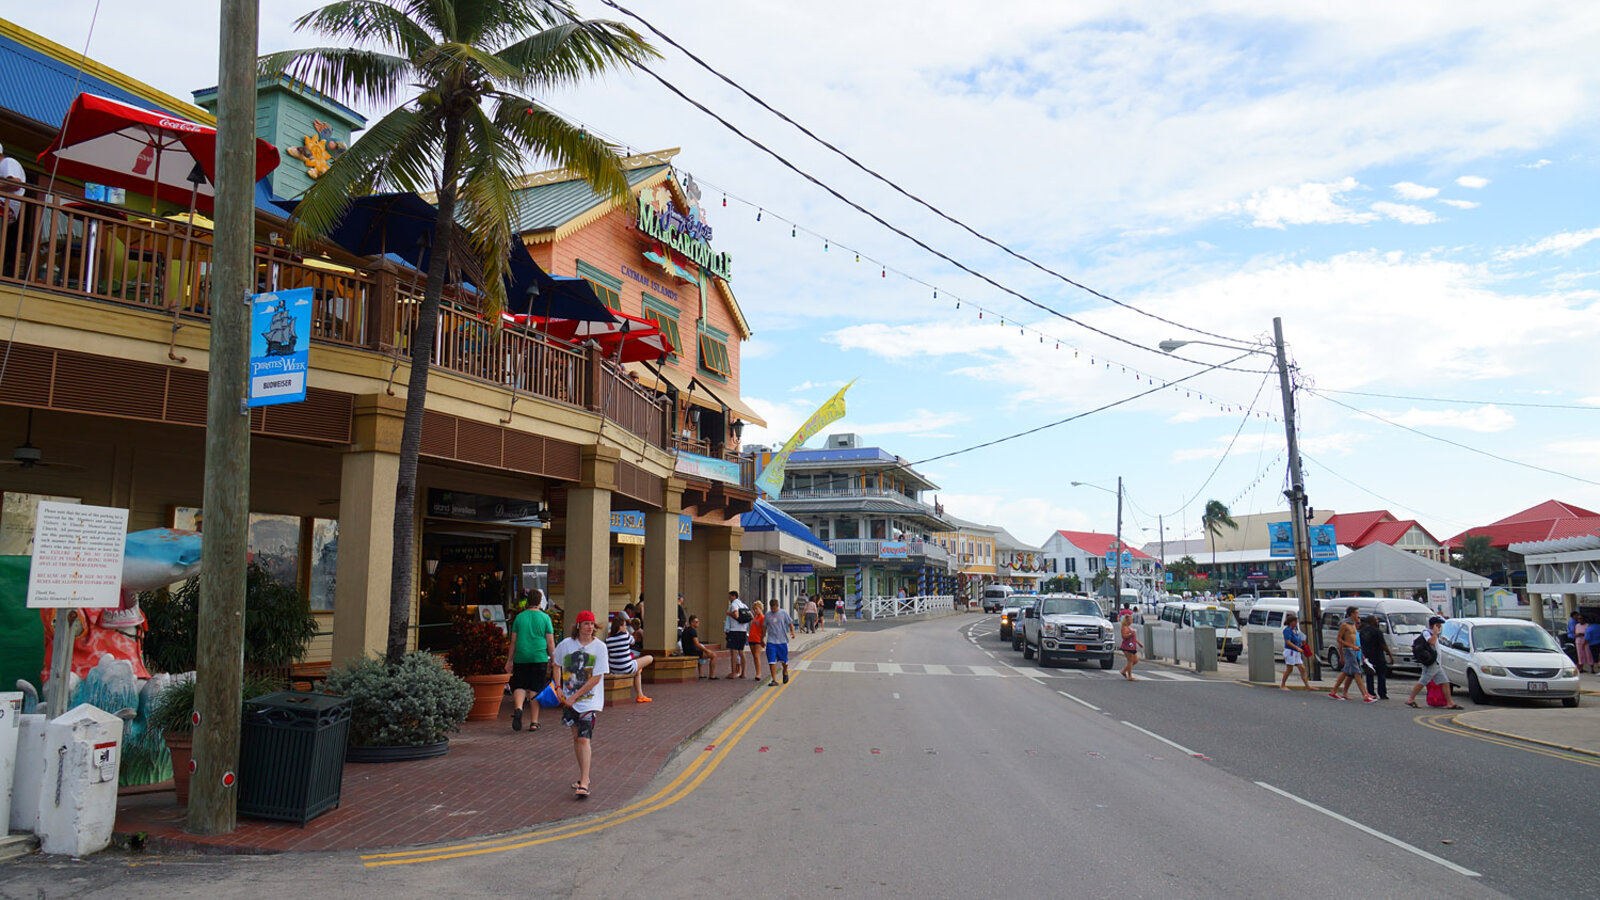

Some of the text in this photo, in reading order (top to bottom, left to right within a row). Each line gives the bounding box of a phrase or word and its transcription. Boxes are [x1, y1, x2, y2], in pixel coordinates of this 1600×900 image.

[621, 264, 679, 301] CAYMAN ISLANDS
[263, 379, 292, 390] BUDWEISER
[610, 512, 622, 526] HE
[622, 514, 645, 529] ISLA
